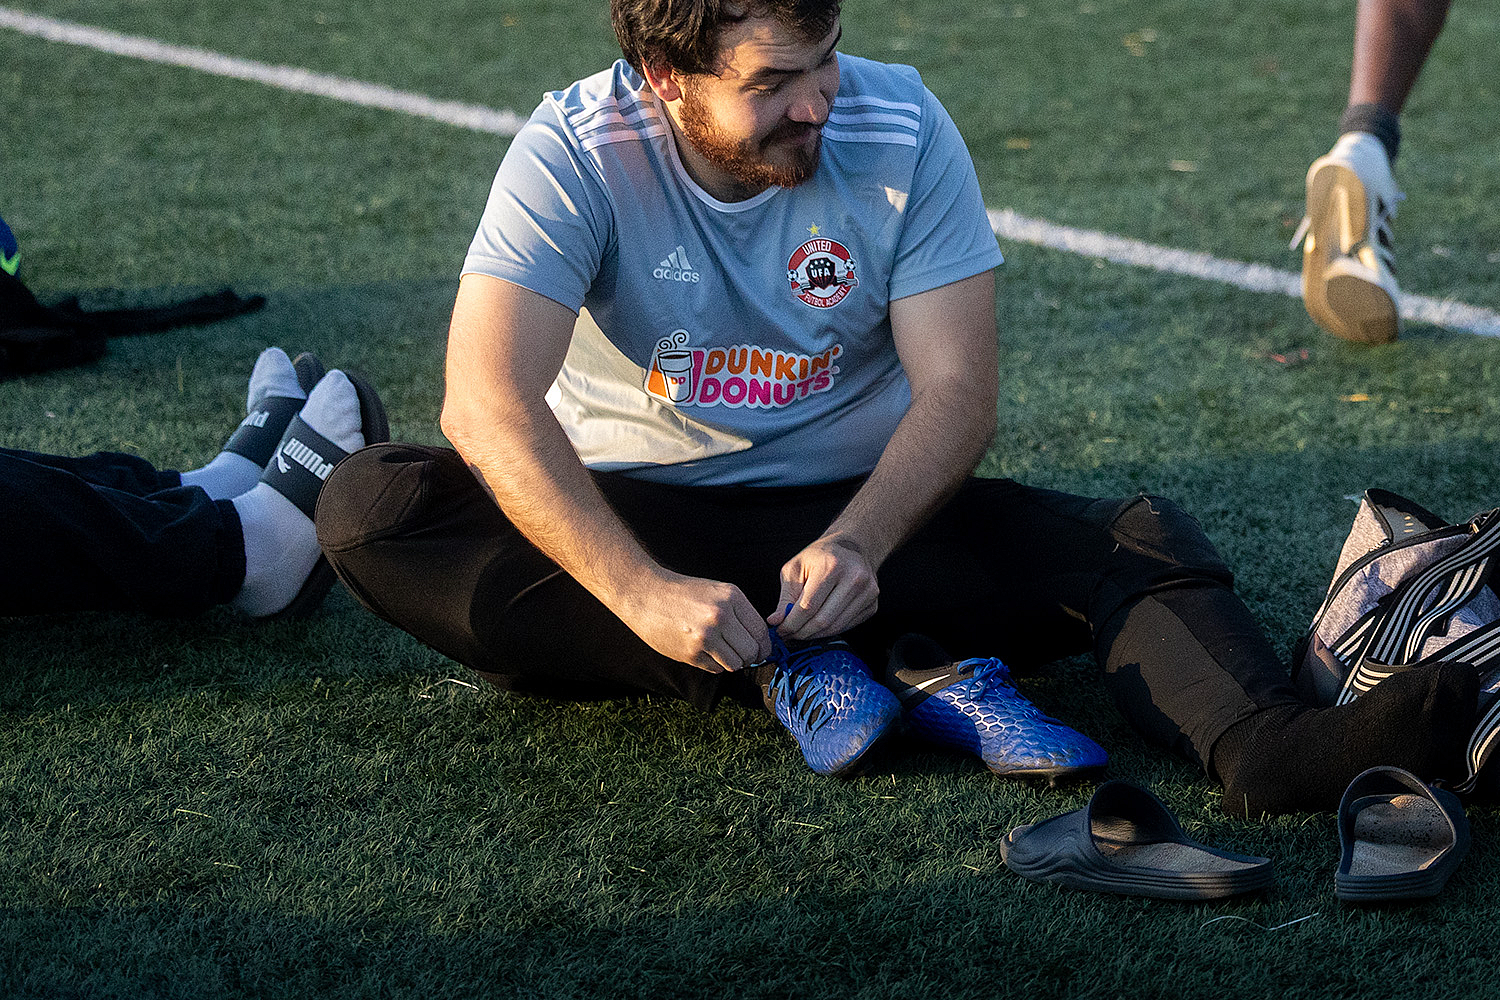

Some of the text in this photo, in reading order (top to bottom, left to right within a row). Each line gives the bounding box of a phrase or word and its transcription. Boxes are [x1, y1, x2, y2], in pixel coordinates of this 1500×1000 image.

[802, 240, 832, 256] UNITED
[652, 267, 700, 284] adidas
[811, 267, 831, 278] UFA
[704, 346, 840, 380] DUNKIN'
[701, 370, 831, 404] DONUTS
[283, 437, 334, 481] PUMA
